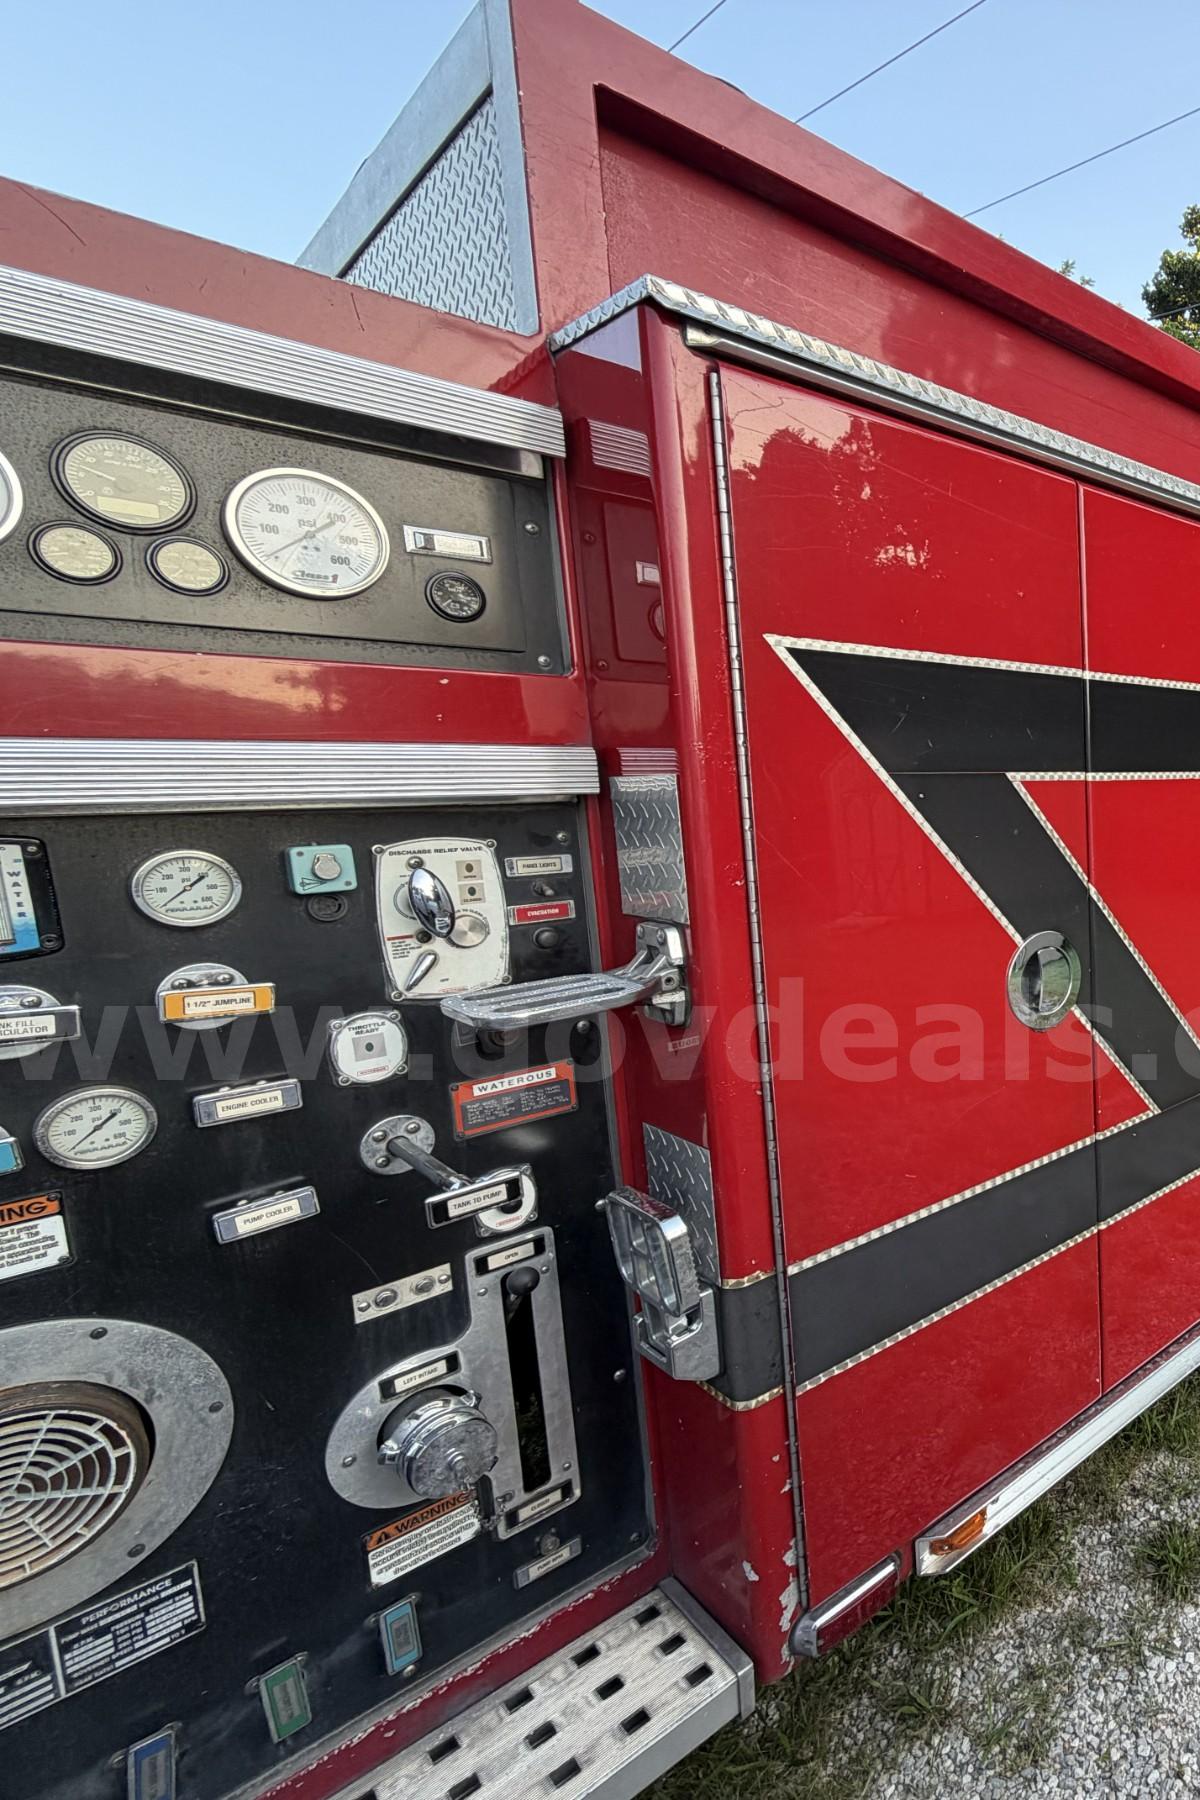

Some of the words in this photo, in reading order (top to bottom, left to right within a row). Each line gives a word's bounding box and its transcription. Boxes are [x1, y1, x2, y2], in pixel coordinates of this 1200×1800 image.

[296, 495, 316, 507] 300
[267, 503, 289, 515] 200
[326, 512, 346, 523] 400
[259, 523, 279, 534] 100
[297, 519, 317, 529] psi
[339, 536, 358, 546] 500
[330, 555, 350, 566] 600
[388, 849, 432, 857] DISCHARGE
[6, 870, 28, 918] WATER
[213, 997, 252, 1007] JUMPLINE
[15, 1020, 35, 1028] FILL
[347, 1021, 387, 1032] THROTTLE
[477, 1070, 553, 1093] WATEROUS
[221, 1102, 249, 1112] ENGINE
[250, 1096, 279, 1106] COOLER
[70, 1115, 83, 1123] 200
[63, 1129, 77, 1137] 100
[453, 1200, 472, 1210] TANK
[483, 1190, 502, 1201] PUMP
[243, 1214, 265, 1225] PUMP
[265, 1205, 294, 1218] COOLER
[394, 1492, 470, 1533] WARNING
[81, 1578, 173, 1625] PERFORMANCE
